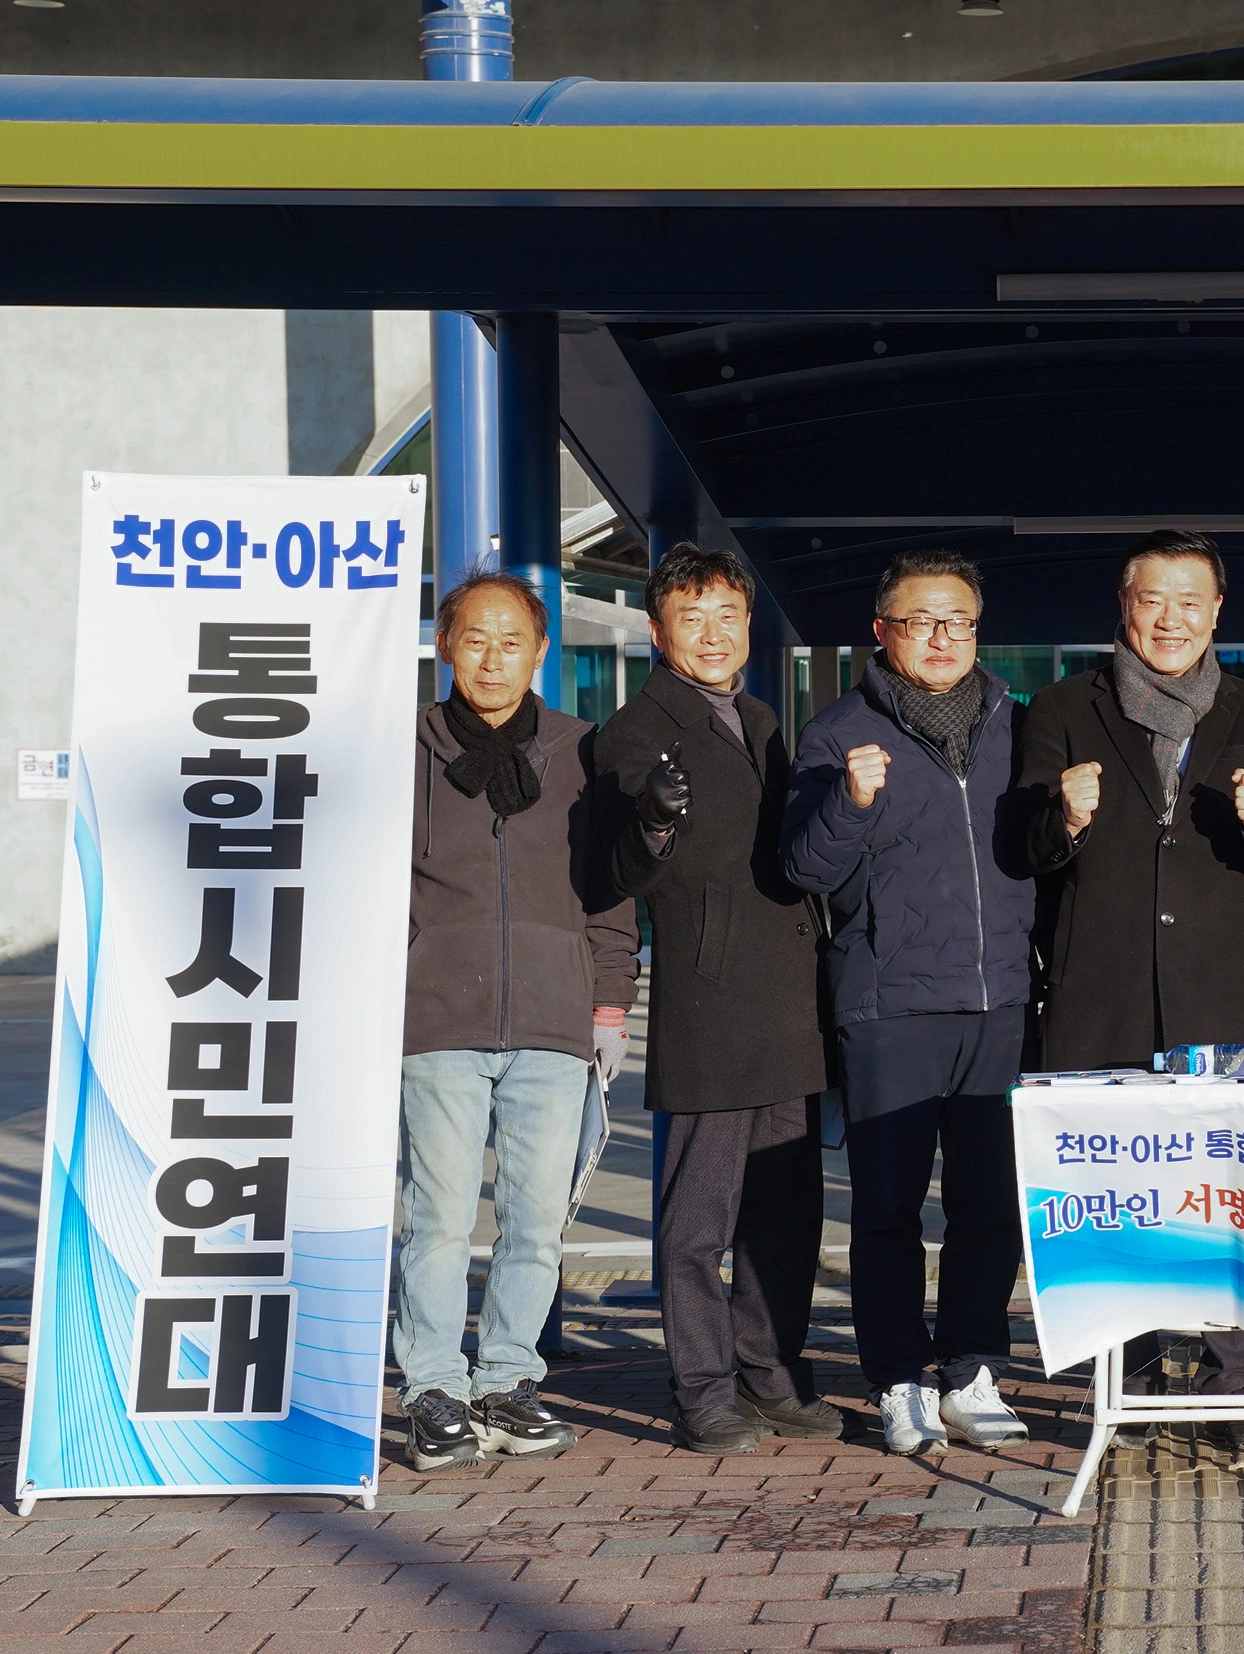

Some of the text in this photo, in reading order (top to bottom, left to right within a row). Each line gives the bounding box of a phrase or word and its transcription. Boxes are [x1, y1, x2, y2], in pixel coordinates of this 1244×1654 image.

[110, 514, 405, 591] 천안·아산
[22, 755, 54, 777] 금연
[134, 621, 319, 1414] 통합시민연대
[1056, 1132, 1195, 1165] 천안·아산
[1043, 1188, 1163, 1237] 10만인
